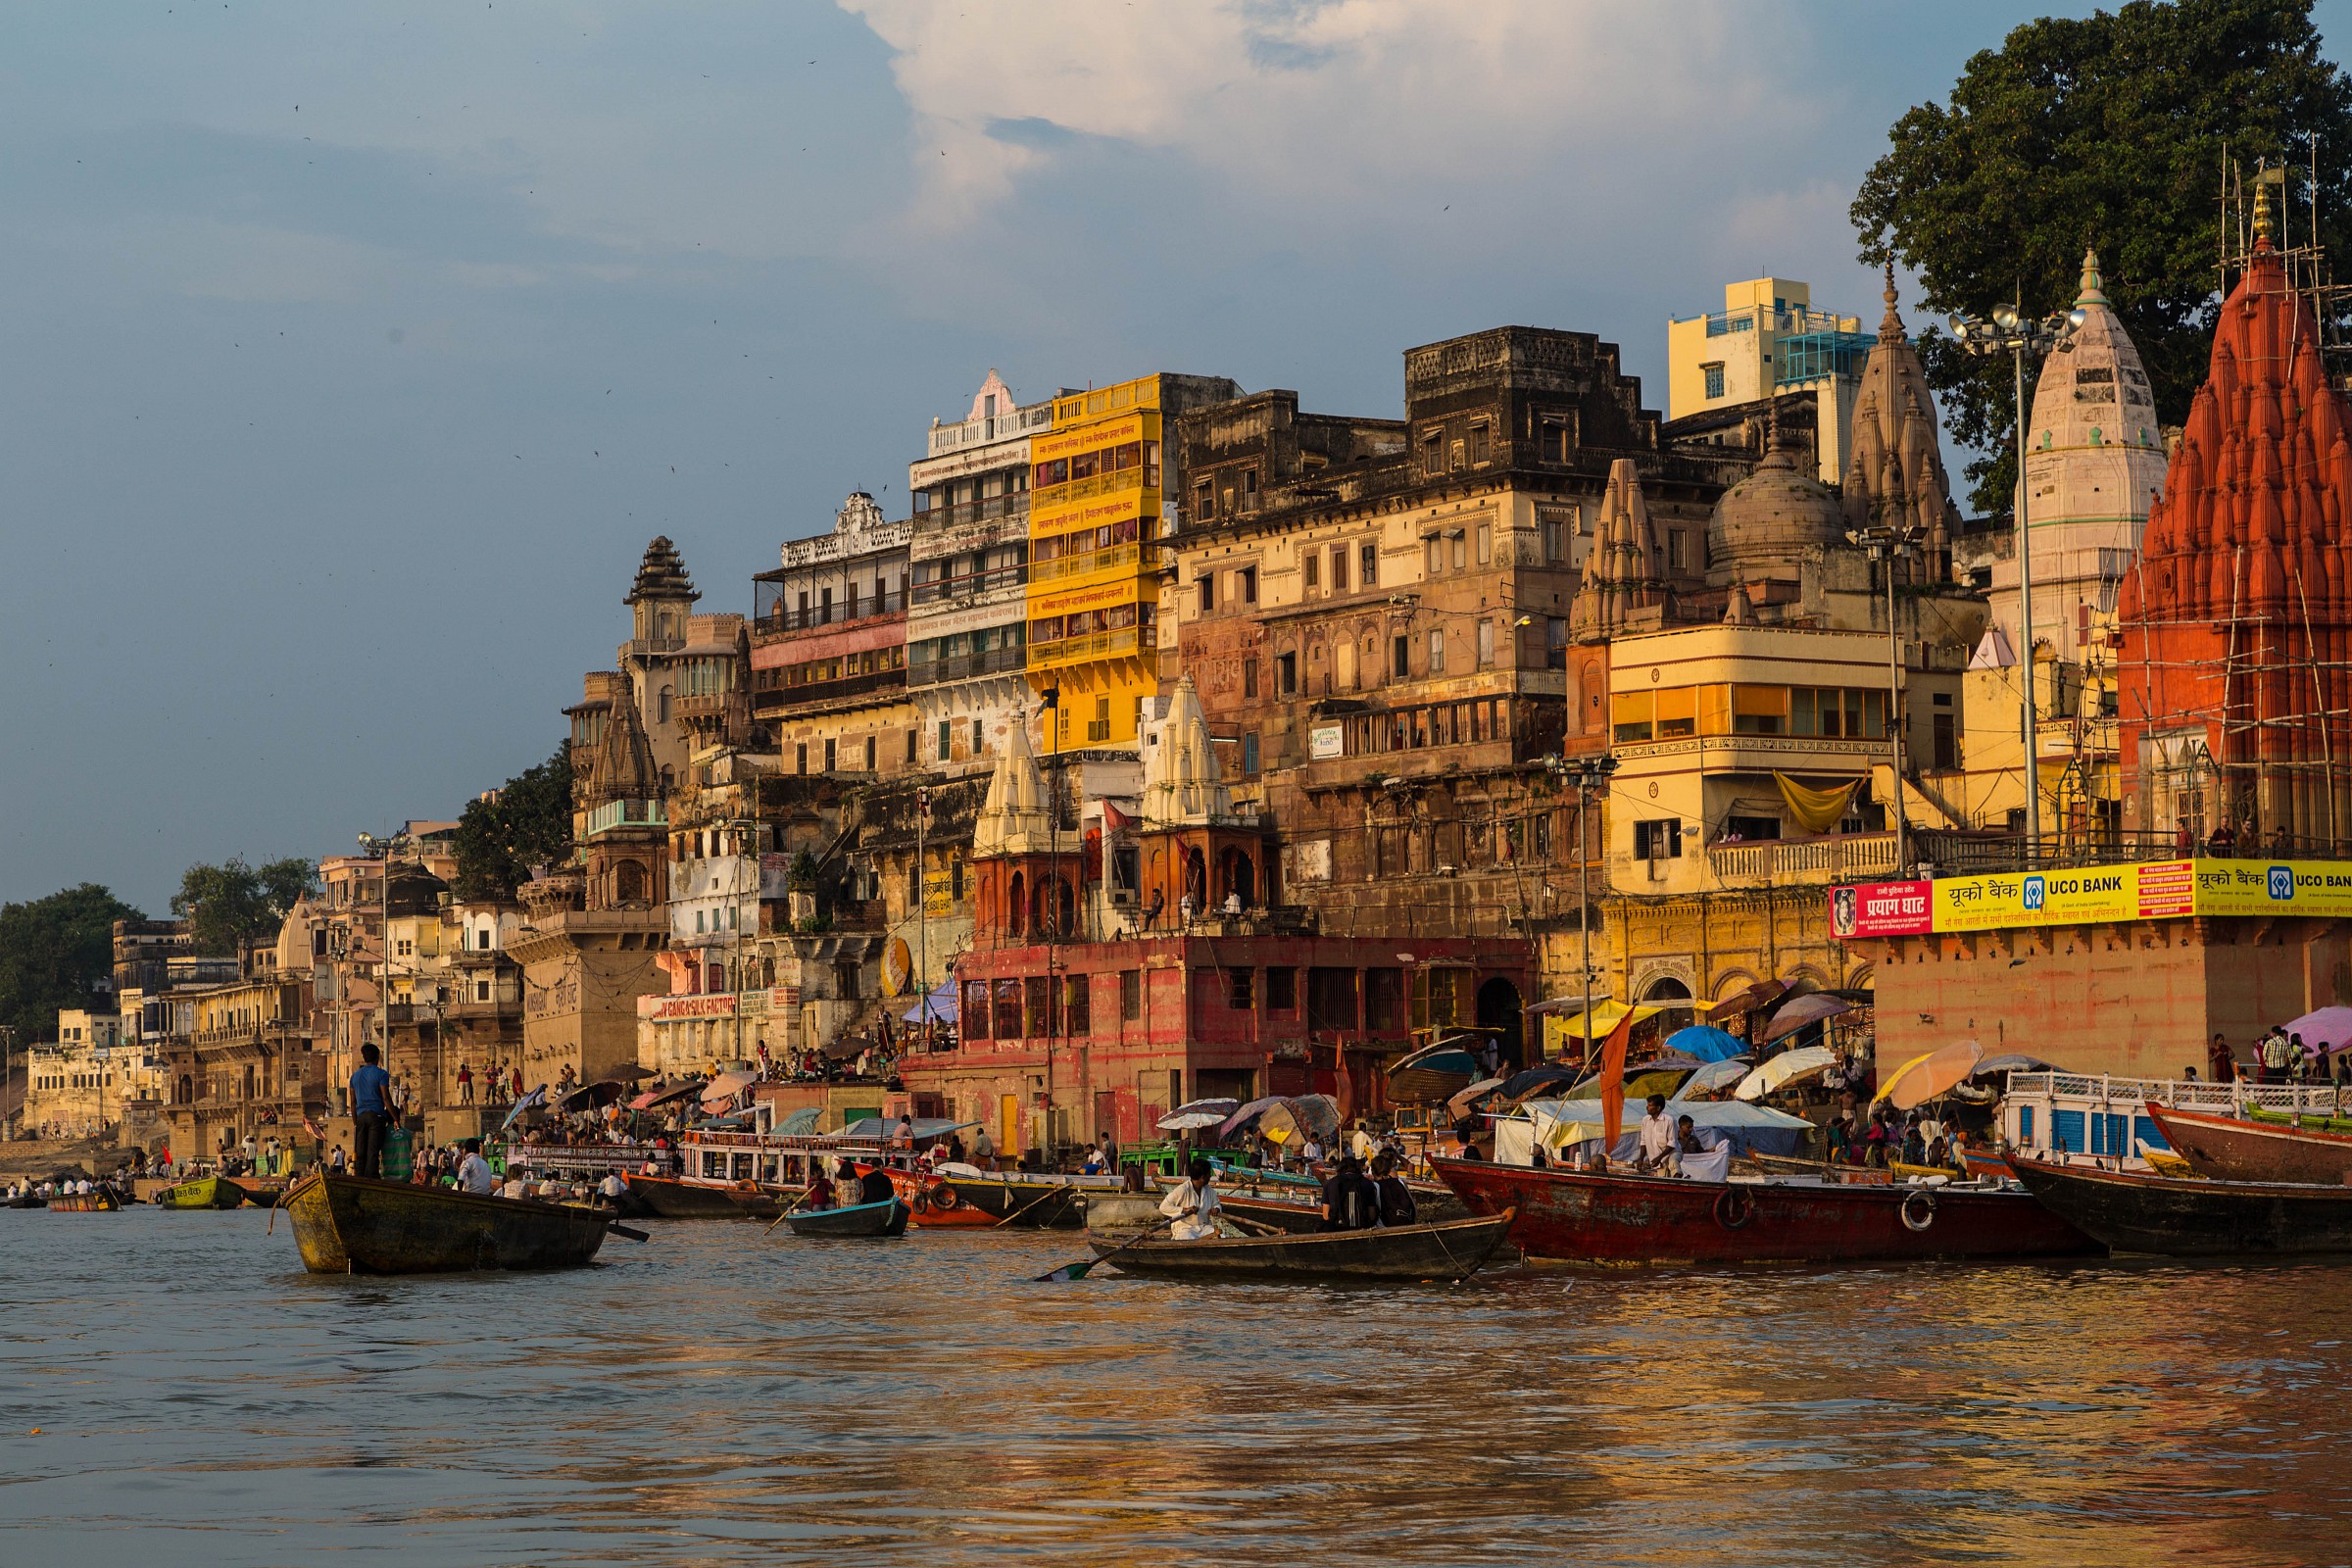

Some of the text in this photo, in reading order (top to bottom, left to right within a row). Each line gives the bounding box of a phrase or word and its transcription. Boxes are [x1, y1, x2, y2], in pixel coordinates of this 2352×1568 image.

[2049, 880, 2079, 895] UCO
[2083, 876, 2122, 893] BANK
[2197, 869, 2231, 890] यूको
[2235, 869, 2265, 886] बैंक
[2296, 875, 2352, 887] UCO BAN
[1948, 880, 2018, 907] यूको बैंक
[1867, 897, 1926, 917] प्रयाग घाट
